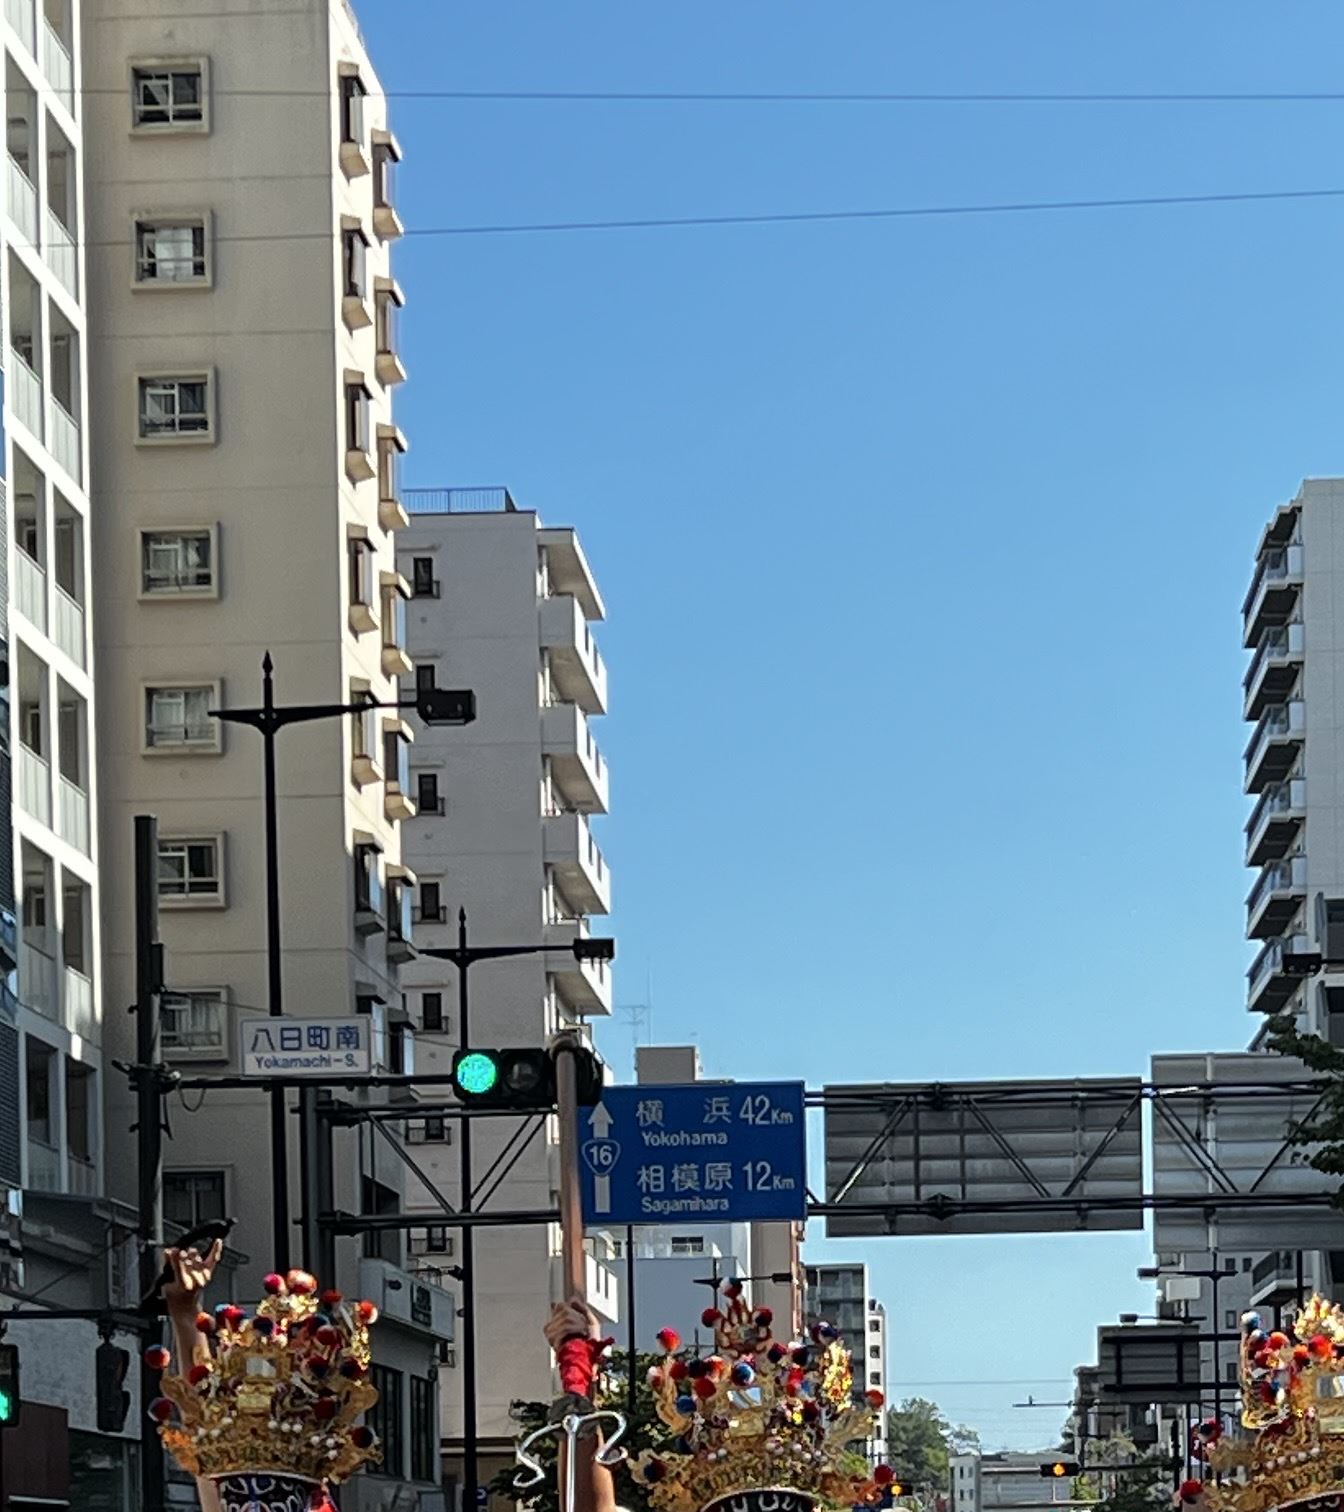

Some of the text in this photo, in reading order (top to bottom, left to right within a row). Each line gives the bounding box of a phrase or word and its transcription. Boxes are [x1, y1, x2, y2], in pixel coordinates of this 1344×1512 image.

[251, 1026, 360, 1052] 八日町南
[641, 1130, 729, 1147] Yokohama
[589, 1145, 613, 1166] 16
[637, 1162, 733, 1193] 相模原
[641, 1196, 730, 1216] Sagamihara
